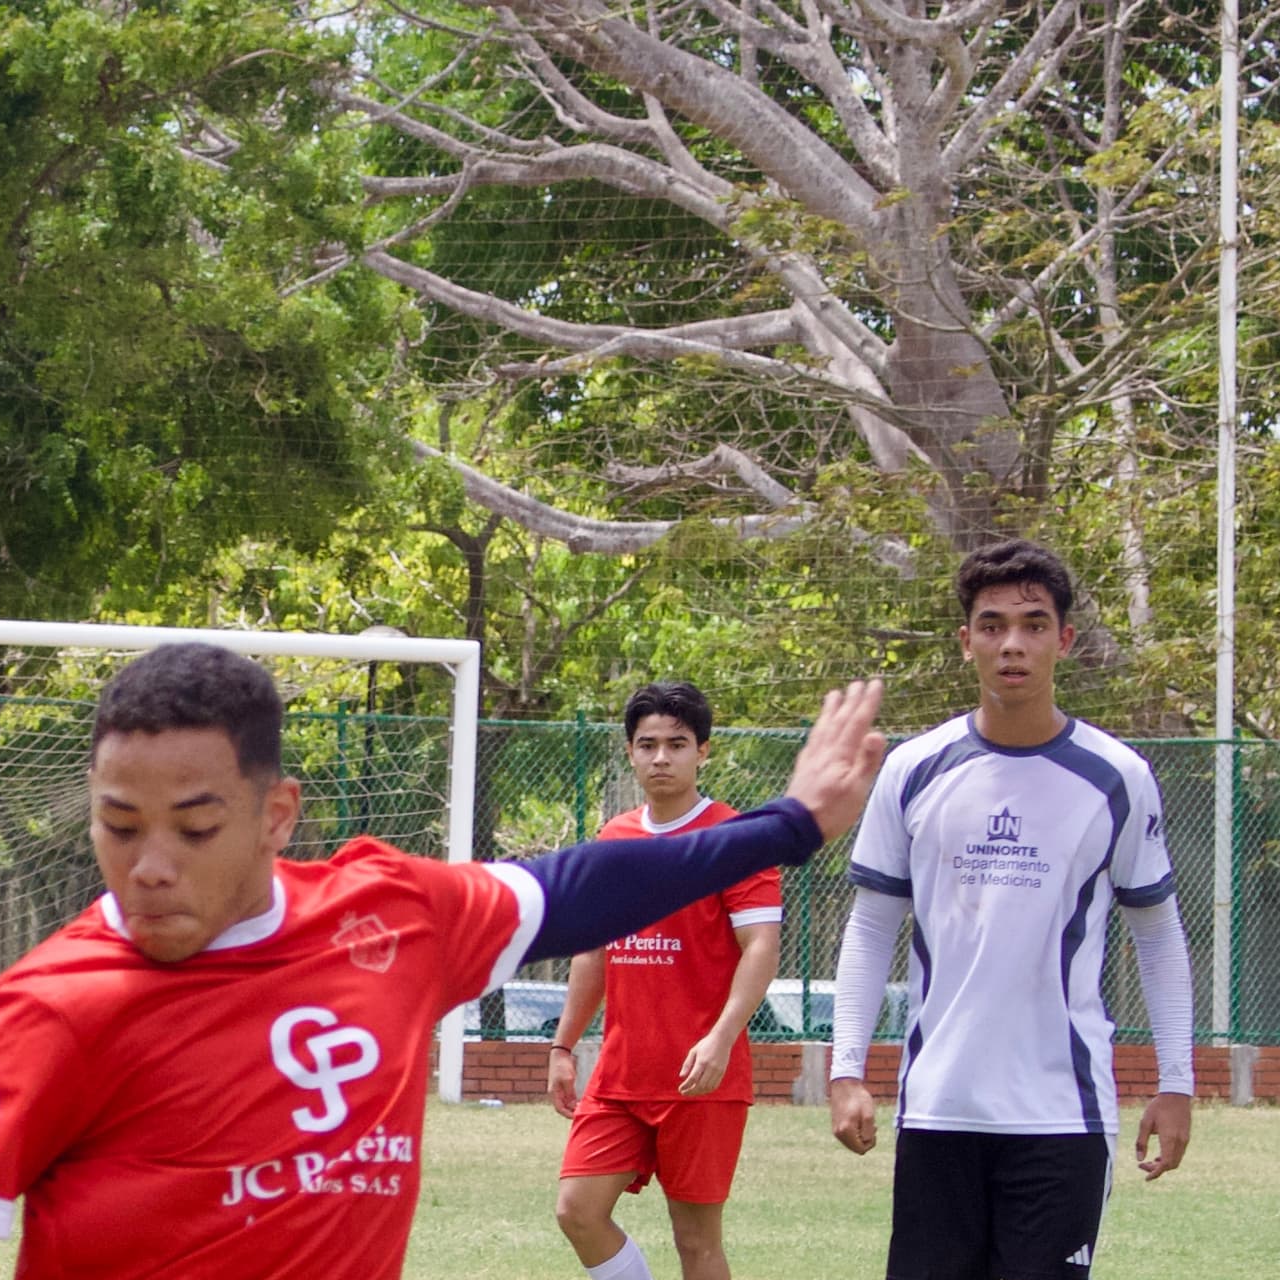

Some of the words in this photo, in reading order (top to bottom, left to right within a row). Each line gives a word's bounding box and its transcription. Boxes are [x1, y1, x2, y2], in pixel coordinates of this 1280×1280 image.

[986, 815, 1022, 838] UN
[966, 844, 1039, 858] UNINORTE
[953, 856, 1050, 873] Departamento
[960, 873, 976, 885] de
[980, 873, 1041, 889] Medicina
[623, 933, 682, 951] Pereira
[222, 1160, 287, 1206] JC
